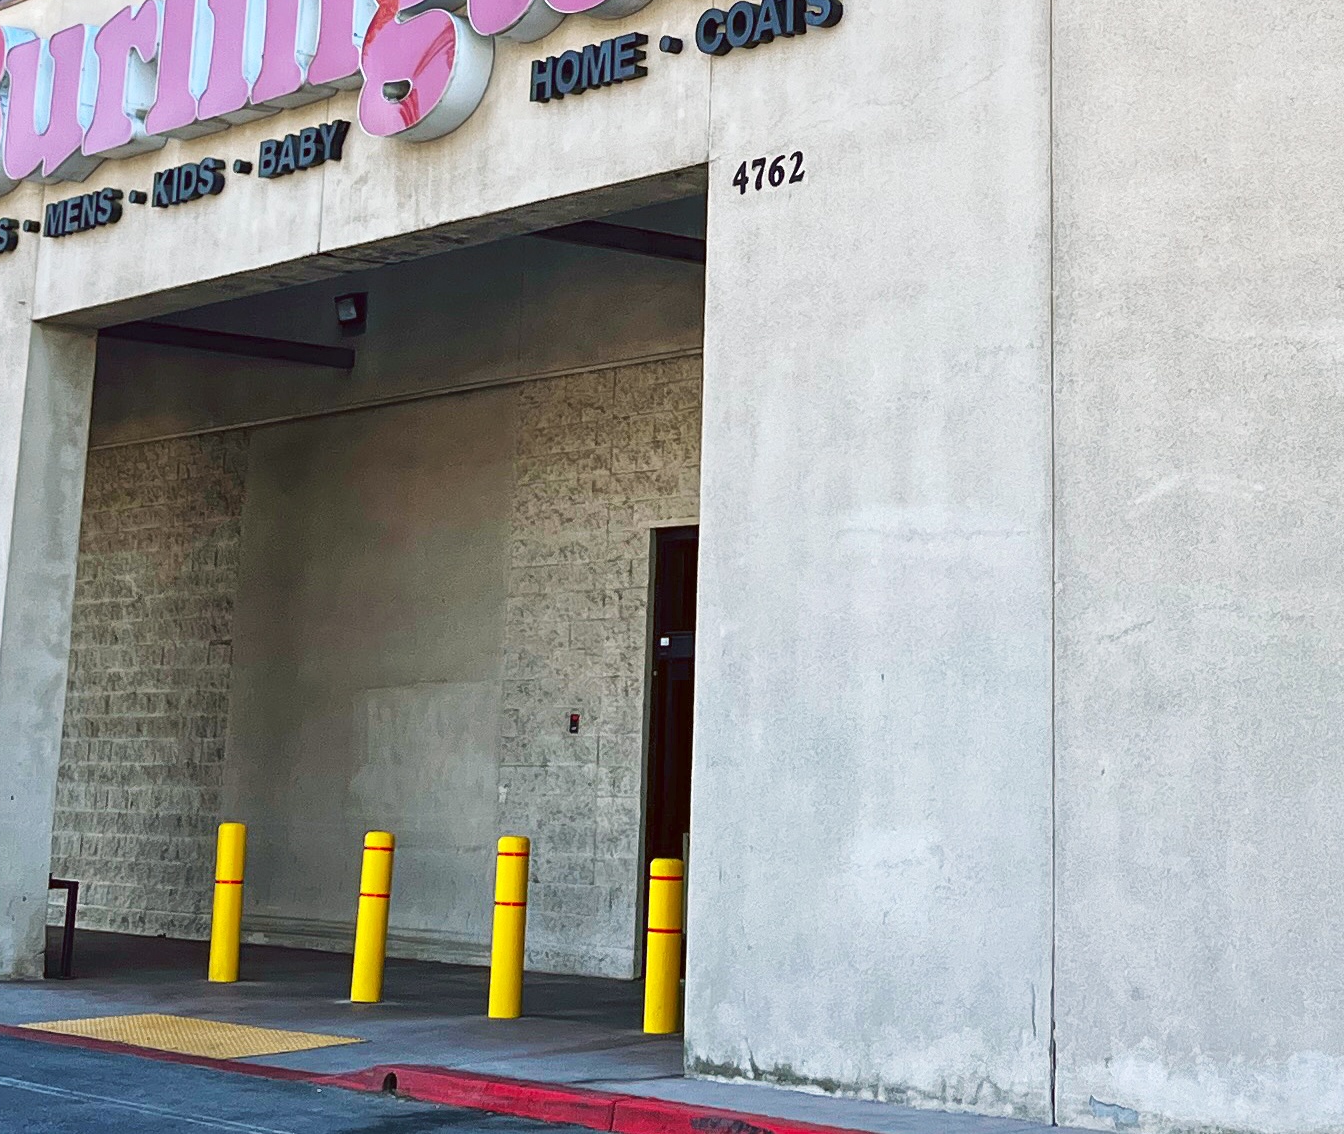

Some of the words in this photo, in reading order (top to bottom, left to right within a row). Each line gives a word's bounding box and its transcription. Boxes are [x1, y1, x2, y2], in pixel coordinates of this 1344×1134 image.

[530, 32, 648, 103] HOME
[44, 187, 123, 237] MENS
[152, 158, 225, 208] KIDS
[258, 120, 351, 178] BABY
[732, 151, 805, 194] 4762
